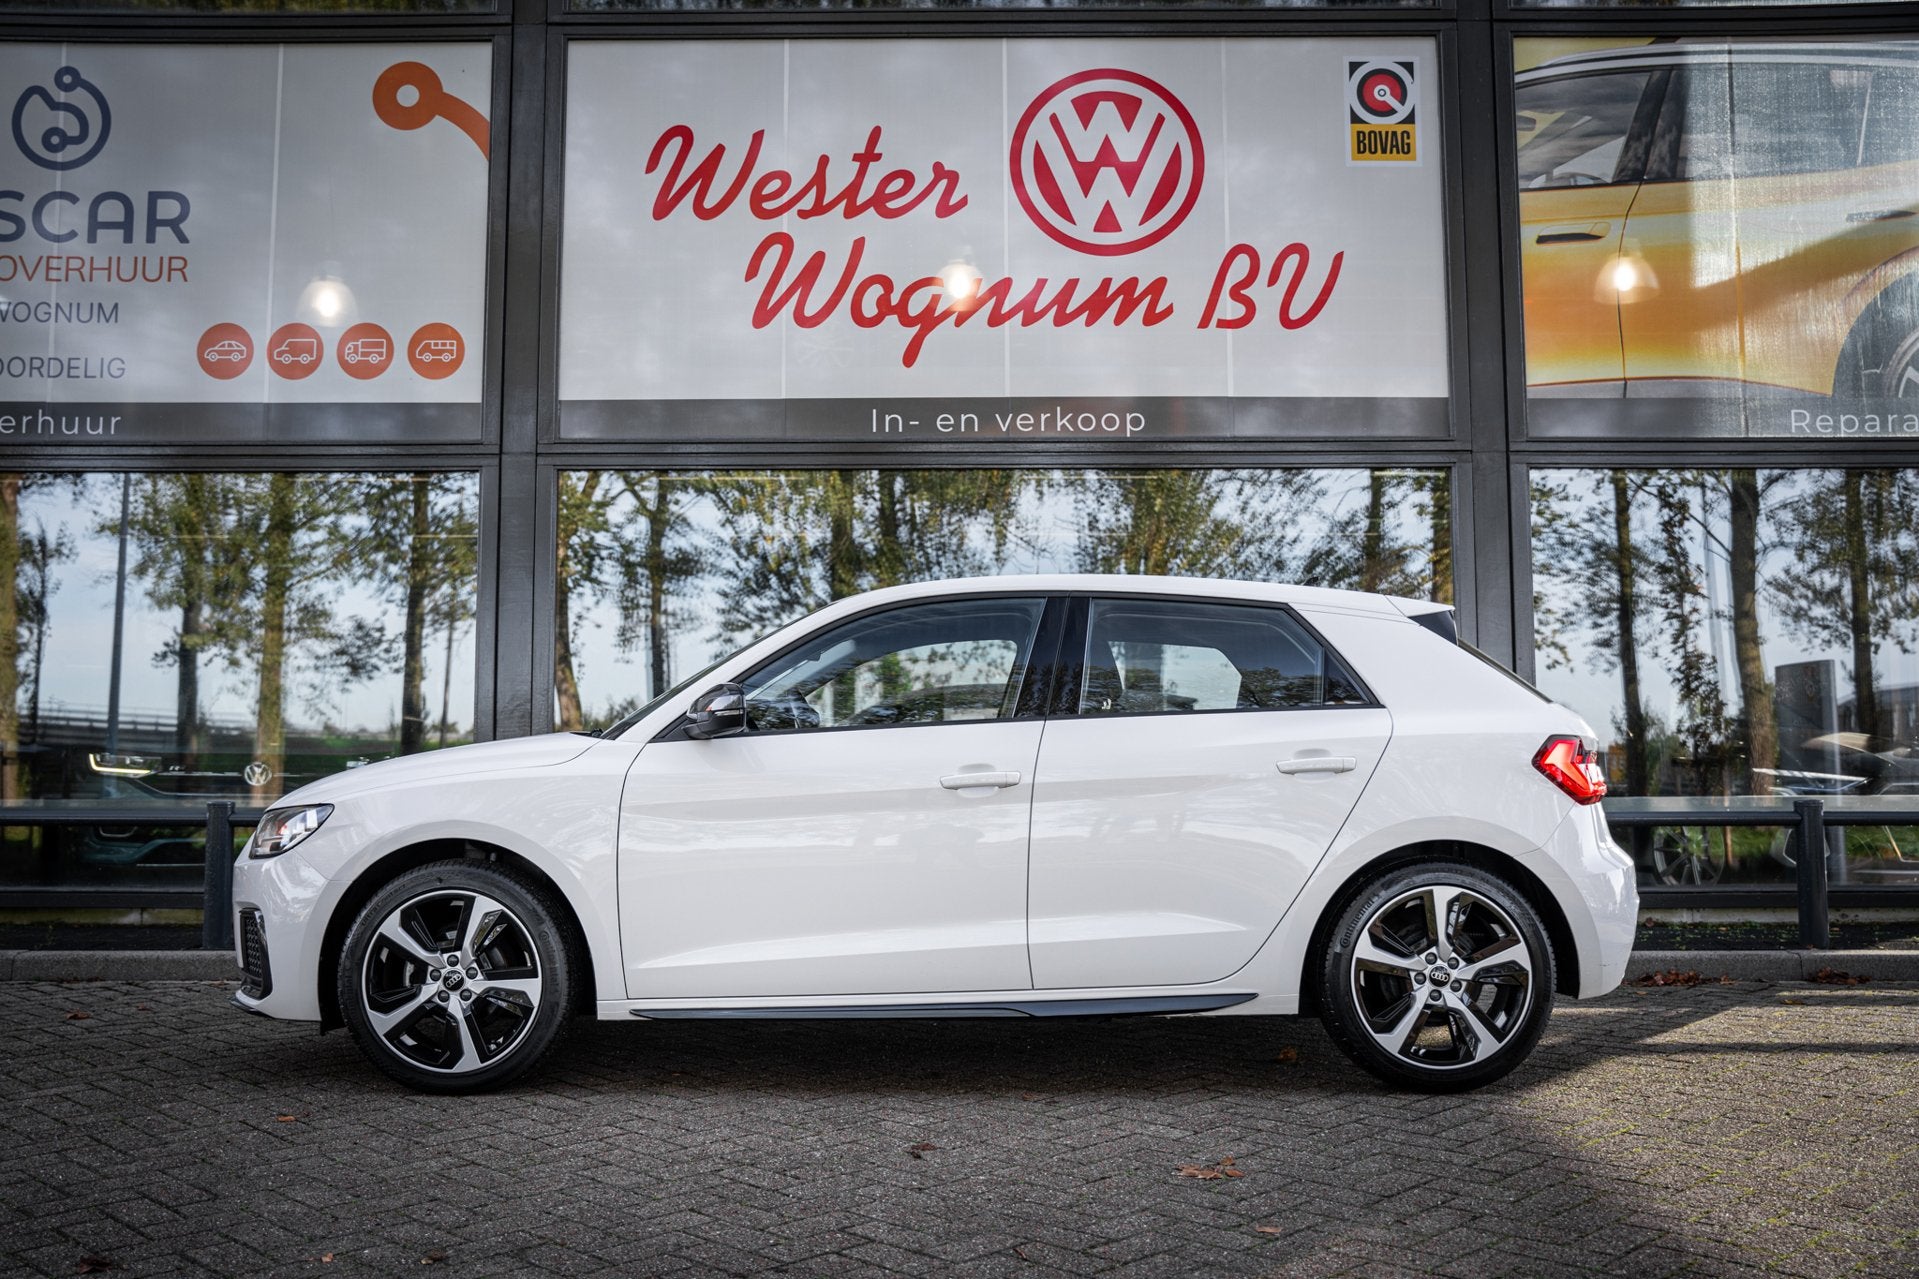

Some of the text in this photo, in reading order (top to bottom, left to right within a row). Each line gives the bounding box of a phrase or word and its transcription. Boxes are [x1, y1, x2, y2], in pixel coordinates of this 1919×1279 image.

[1356, 130, 1411, 155] BOVAG
[646, 125, 967, 221] Wester
[745, 232, 1343, 367] Wognum BV
[0, 356, 126, 379] ORDELIG
[872, 406, 1145, 437] In- en verkoop
[1790, 409, 1919, 437] Repara
